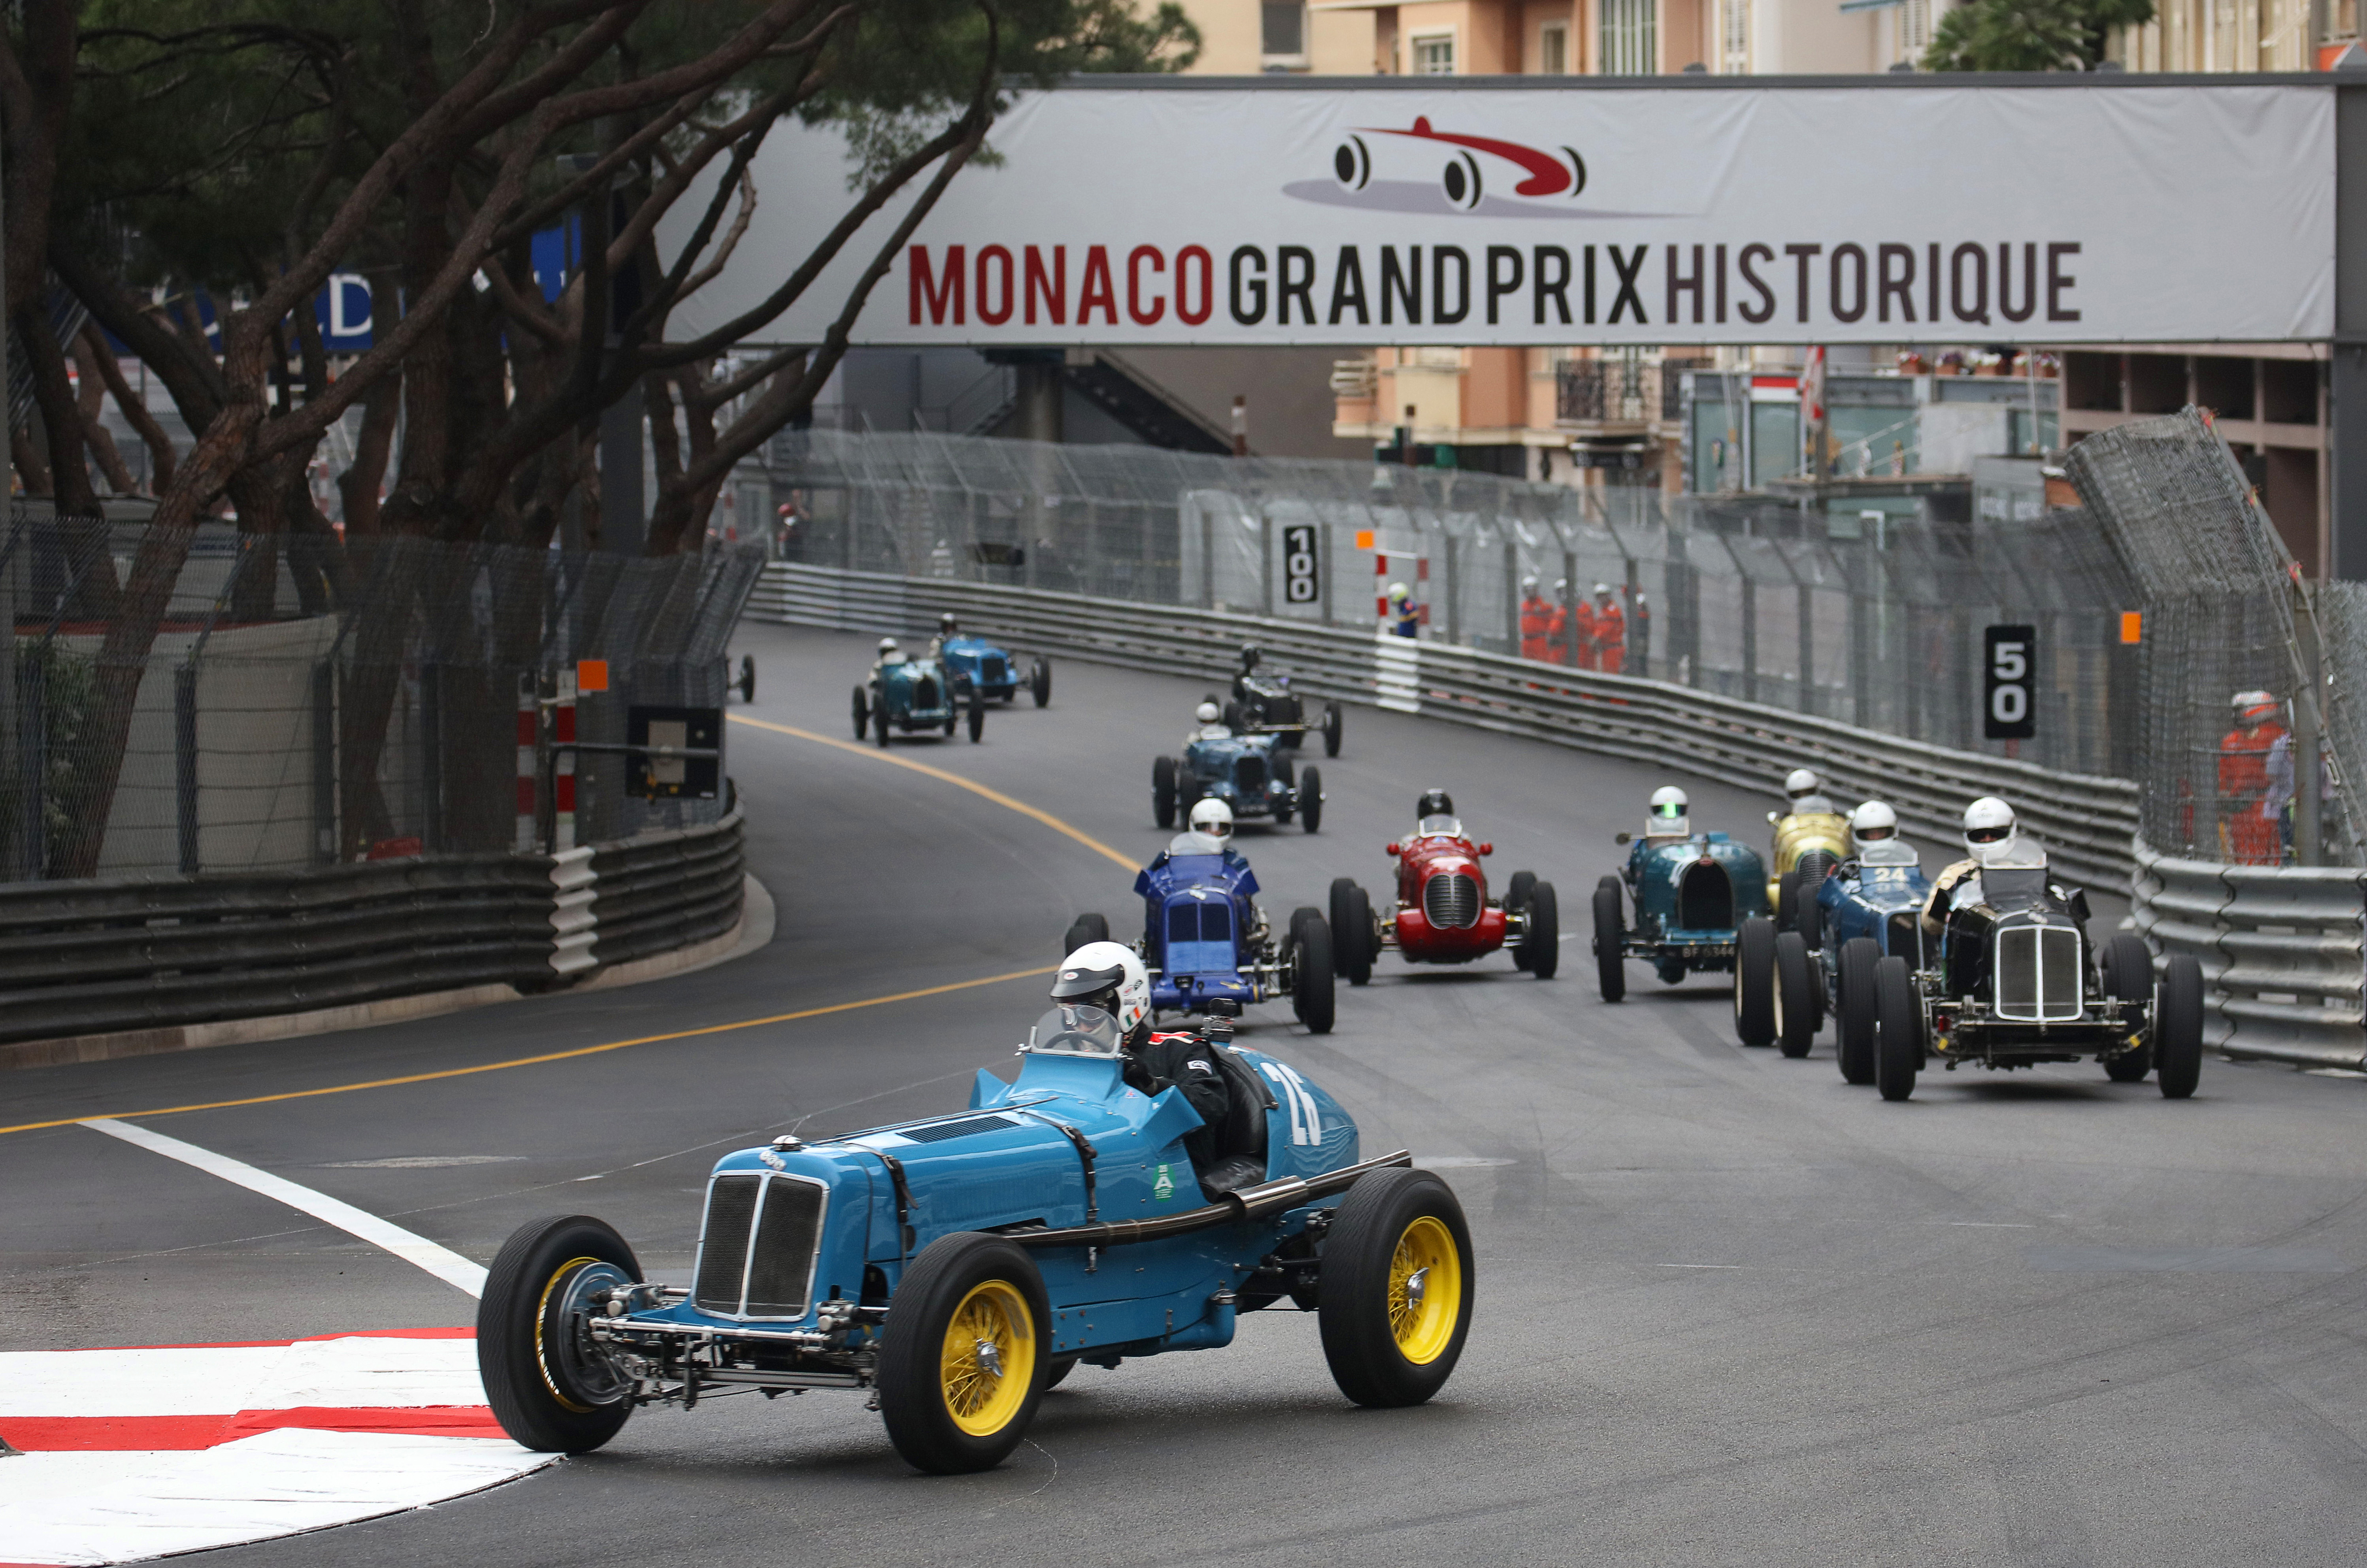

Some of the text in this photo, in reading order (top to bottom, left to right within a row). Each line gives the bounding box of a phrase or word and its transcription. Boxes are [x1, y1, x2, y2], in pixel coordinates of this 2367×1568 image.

[909, 242, 2082, 326] MONACO GRAND PRIX HISTORIQUE
[1290, 528, 1313, 600] 100
[1993, 641, 2027, 723] 50
[1874, 867, 1909, 882] 24
[1260, 1062, 1322, 1146] 26
[1153, 1176, 1174, 1190] A
